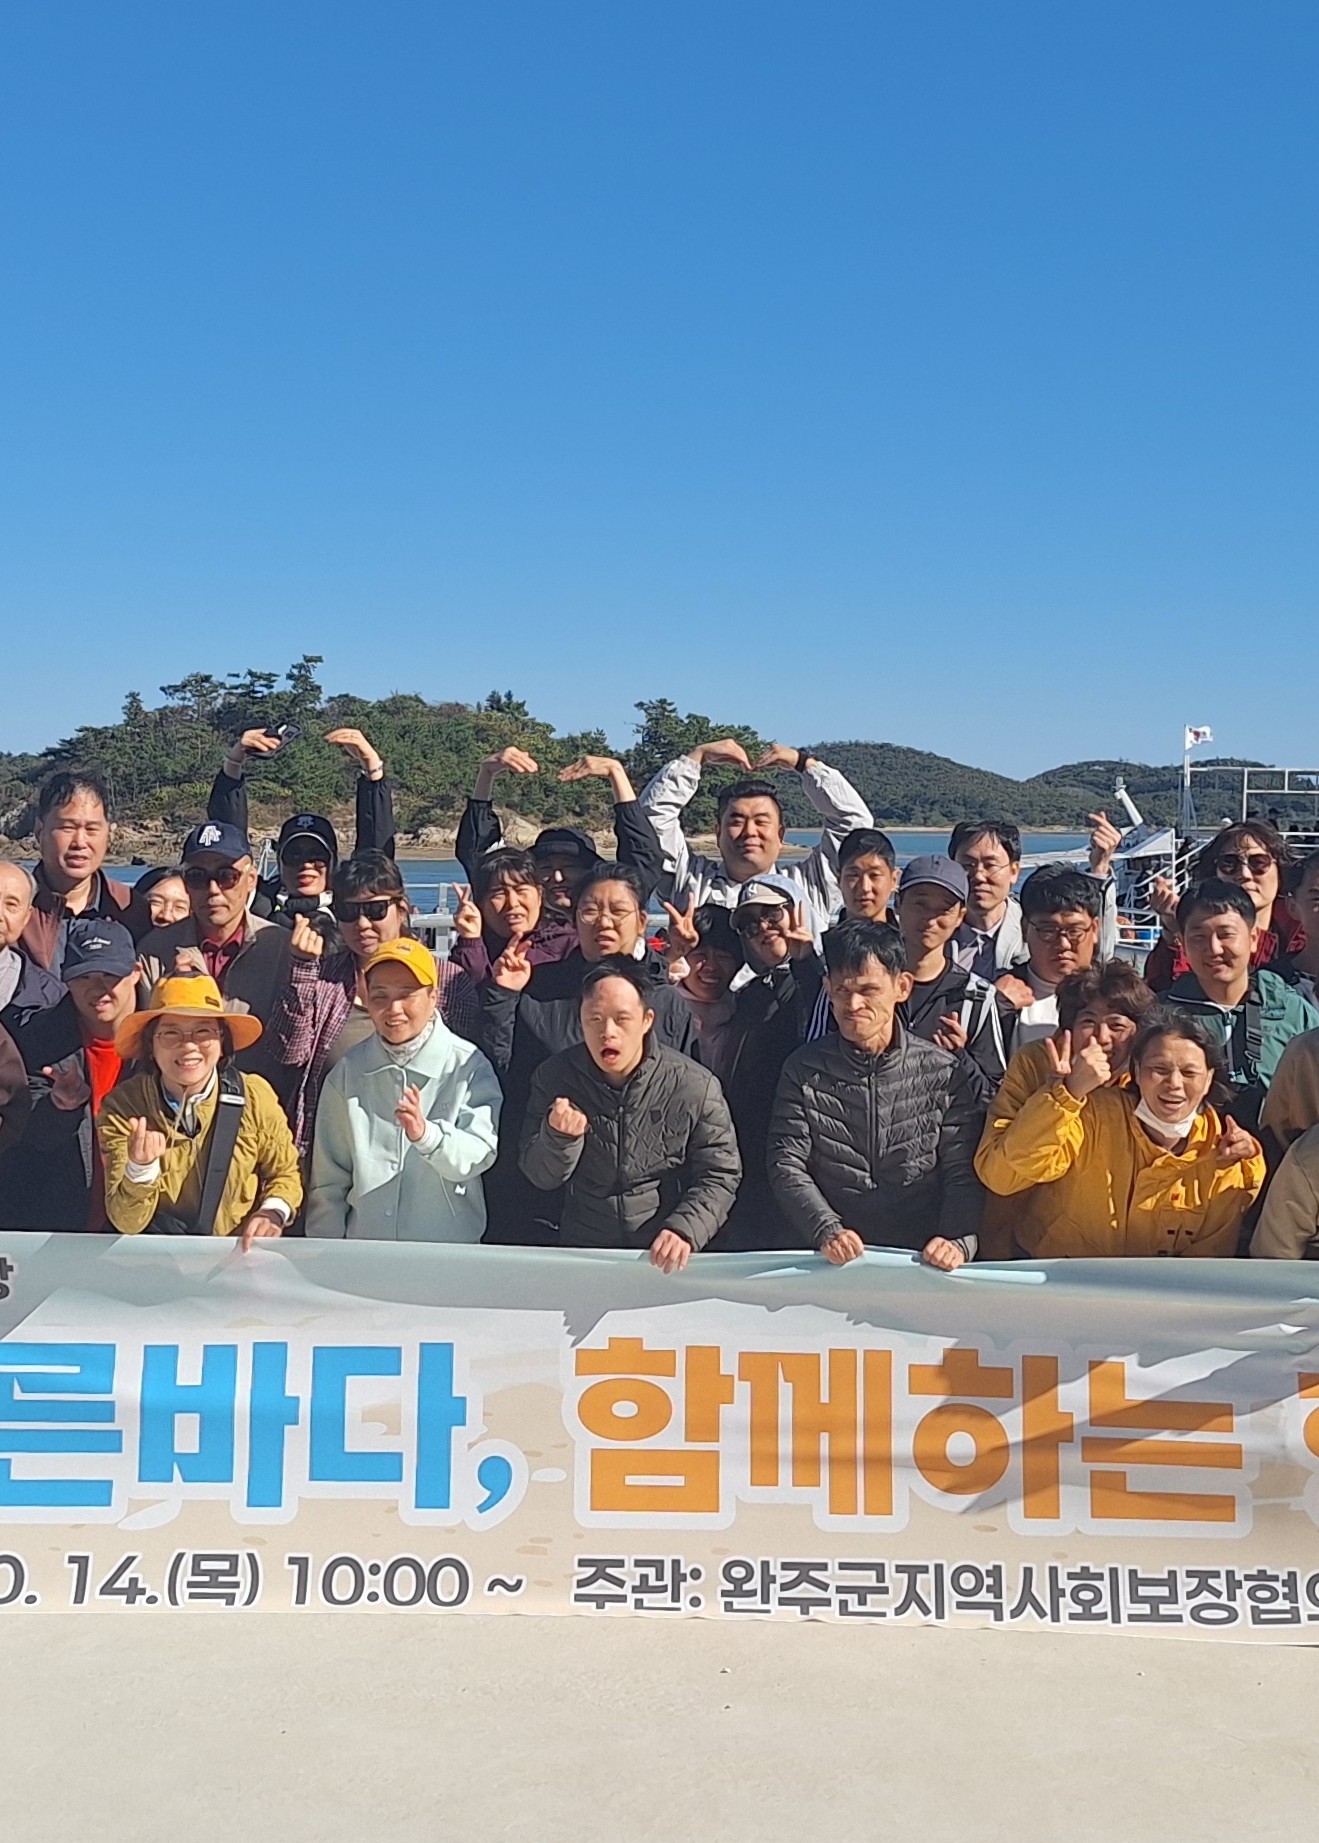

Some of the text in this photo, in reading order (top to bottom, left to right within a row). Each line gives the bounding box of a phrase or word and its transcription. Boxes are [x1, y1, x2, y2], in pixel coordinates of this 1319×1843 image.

[576, 1337, 1243, 1522] 함께하는
[67, 1551, 260, 1607] 14.(목)
[286, 1555, 470, 1607] 10:00
[574, 1557, 702, 1612] 주관:
